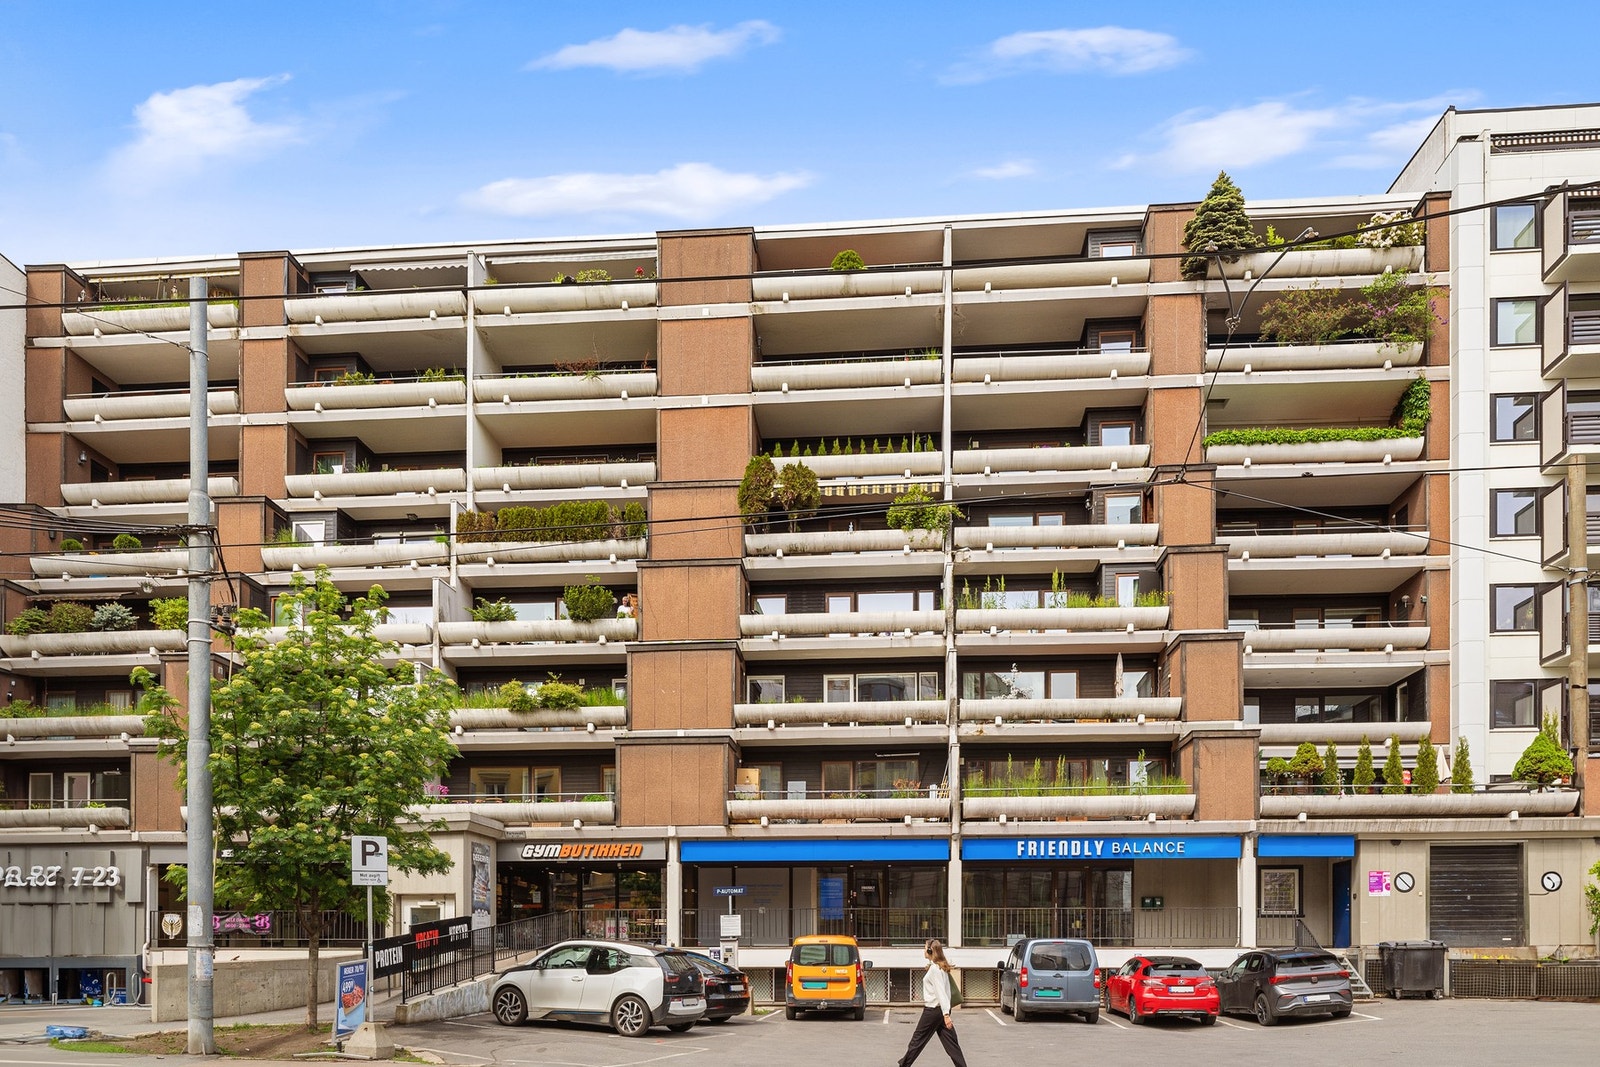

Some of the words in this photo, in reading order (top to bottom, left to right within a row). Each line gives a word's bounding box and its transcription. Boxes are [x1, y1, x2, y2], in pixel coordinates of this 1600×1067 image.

[361, 840, 380, 866] P
[521, 843, 643, 859] GYMBUTIKKEN
[1017, 840, 1104, 856] FRIENDLY
[1111, 842, 1185, 854] BALANCE
[71, 866, 120, 887] 7-23
[375, 946, 403, 969] PROTEIN
